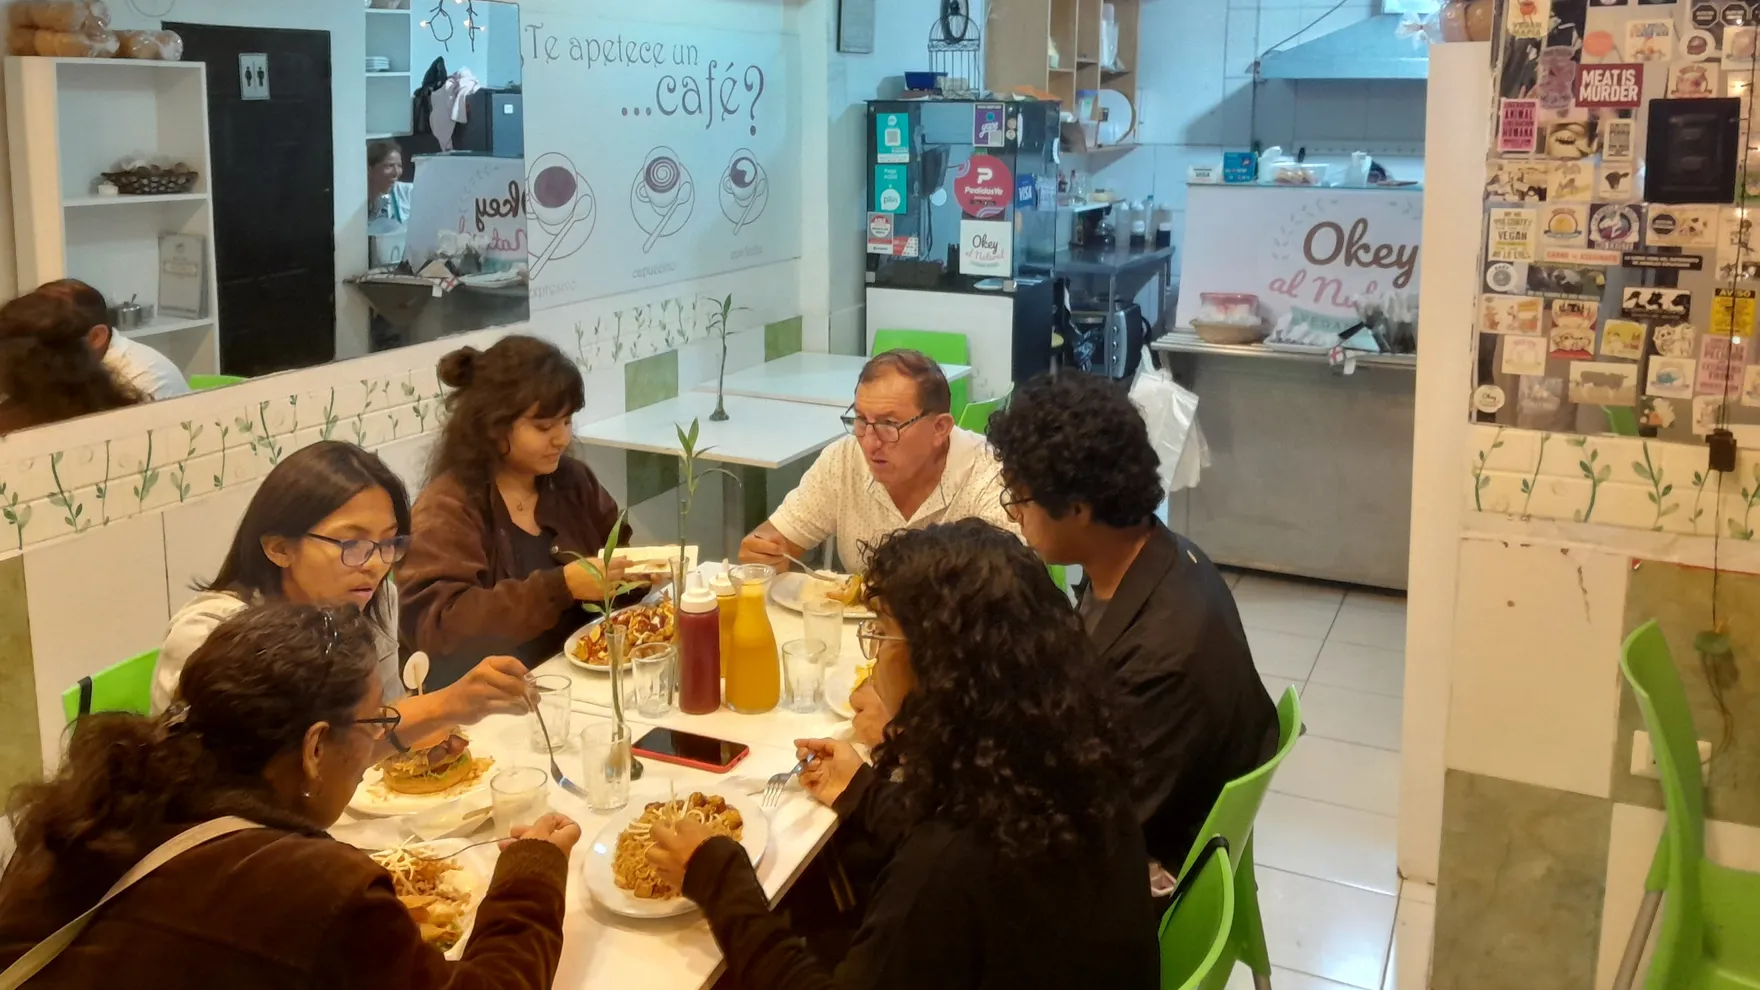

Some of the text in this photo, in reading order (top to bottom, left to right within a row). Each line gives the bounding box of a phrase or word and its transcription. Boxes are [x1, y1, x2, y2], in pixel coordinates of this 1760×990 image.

[524, 23, 698, 69] Te apetece un
[1582, 69, 1636, 87] MEAT IS
[621, 60, 764, 136] ...café?
[1579, 85, 1639, 102] MURDER
[1504, 109, 1533, 119] ANIMAL
[1502, 127, 1533, 137] HUMANA
[1019, 186, 1032, 201] VISA
[972, 233, 999, 255] Okey
[1498, 231, 1527, 240] VEGAN
[1303, 217, 1419, 289] Okey
[1268, 268, 1307, 298] al
[1719, 289, 1751, 297] AVSO
